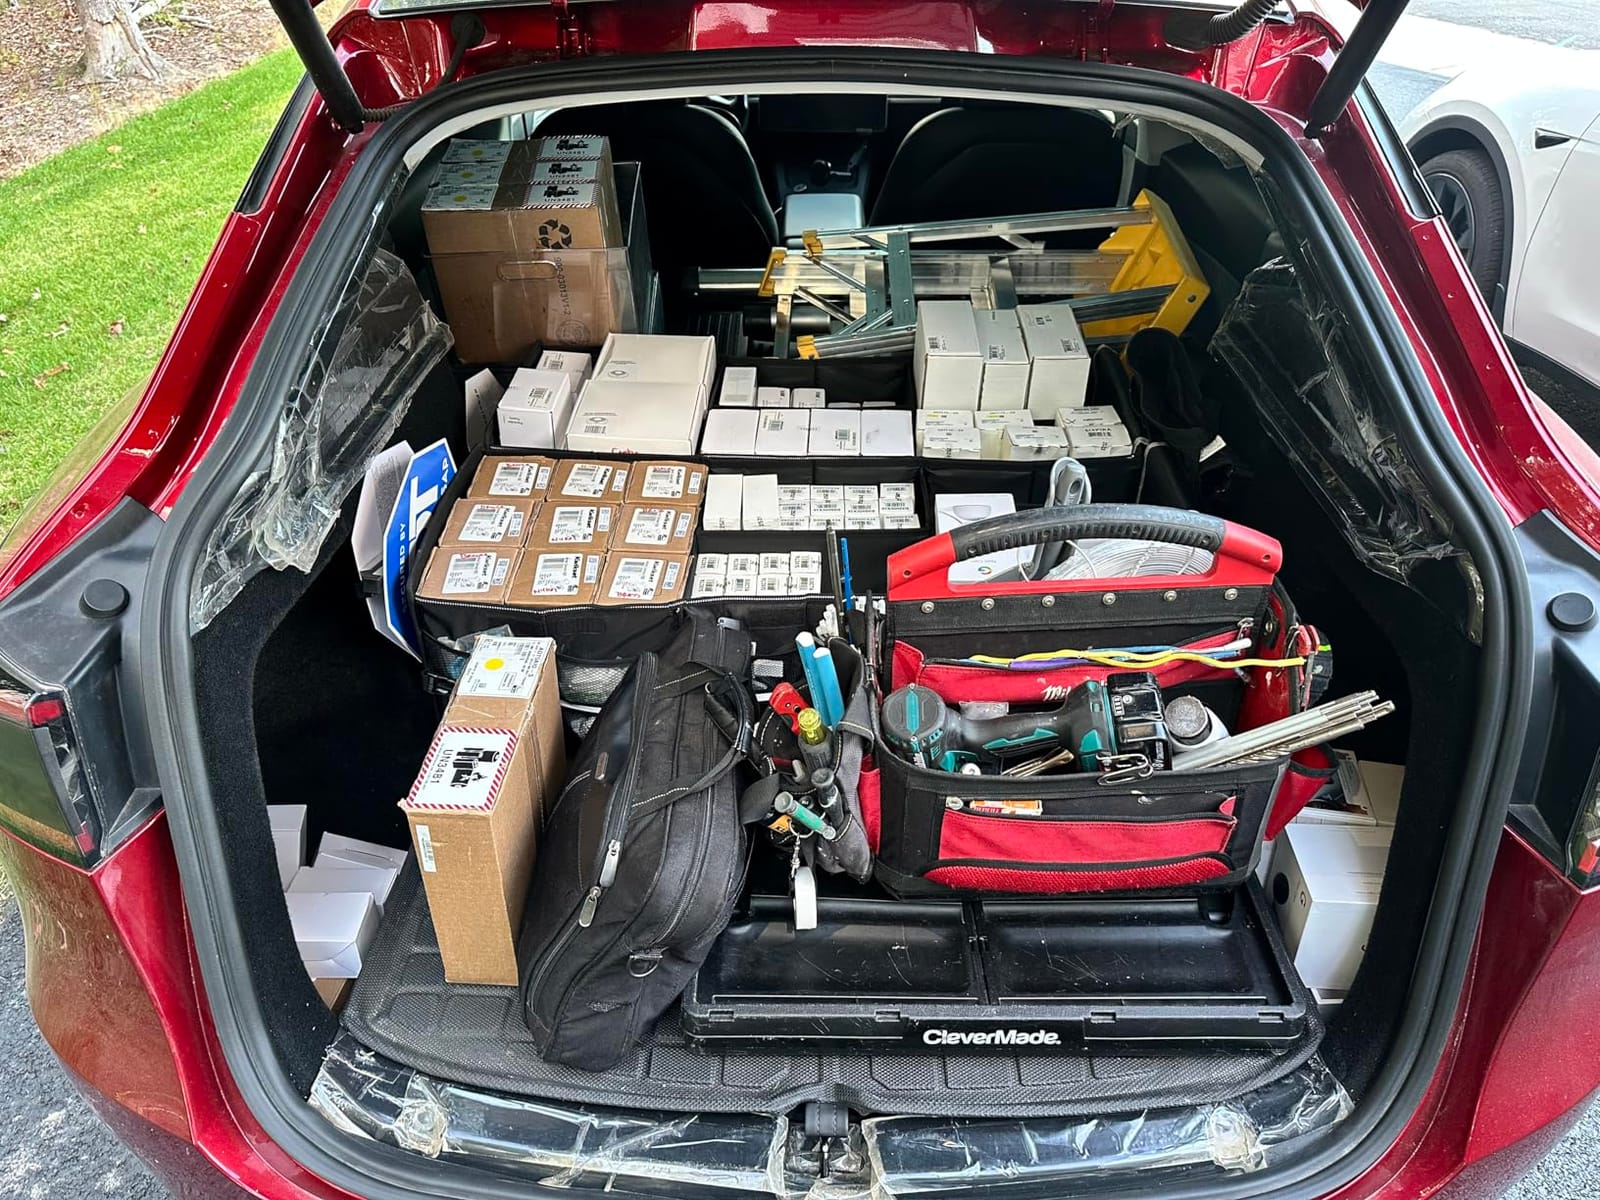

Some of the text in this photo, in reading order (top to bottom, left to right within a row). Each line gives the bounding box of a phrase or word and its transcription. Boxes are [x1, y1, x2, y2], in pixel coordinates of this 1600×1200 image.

[399, 522, 406, 541] BY
[430, 749, 454, 784] UN3481
[923, 1029, 1062, 1045] CleverMade.
